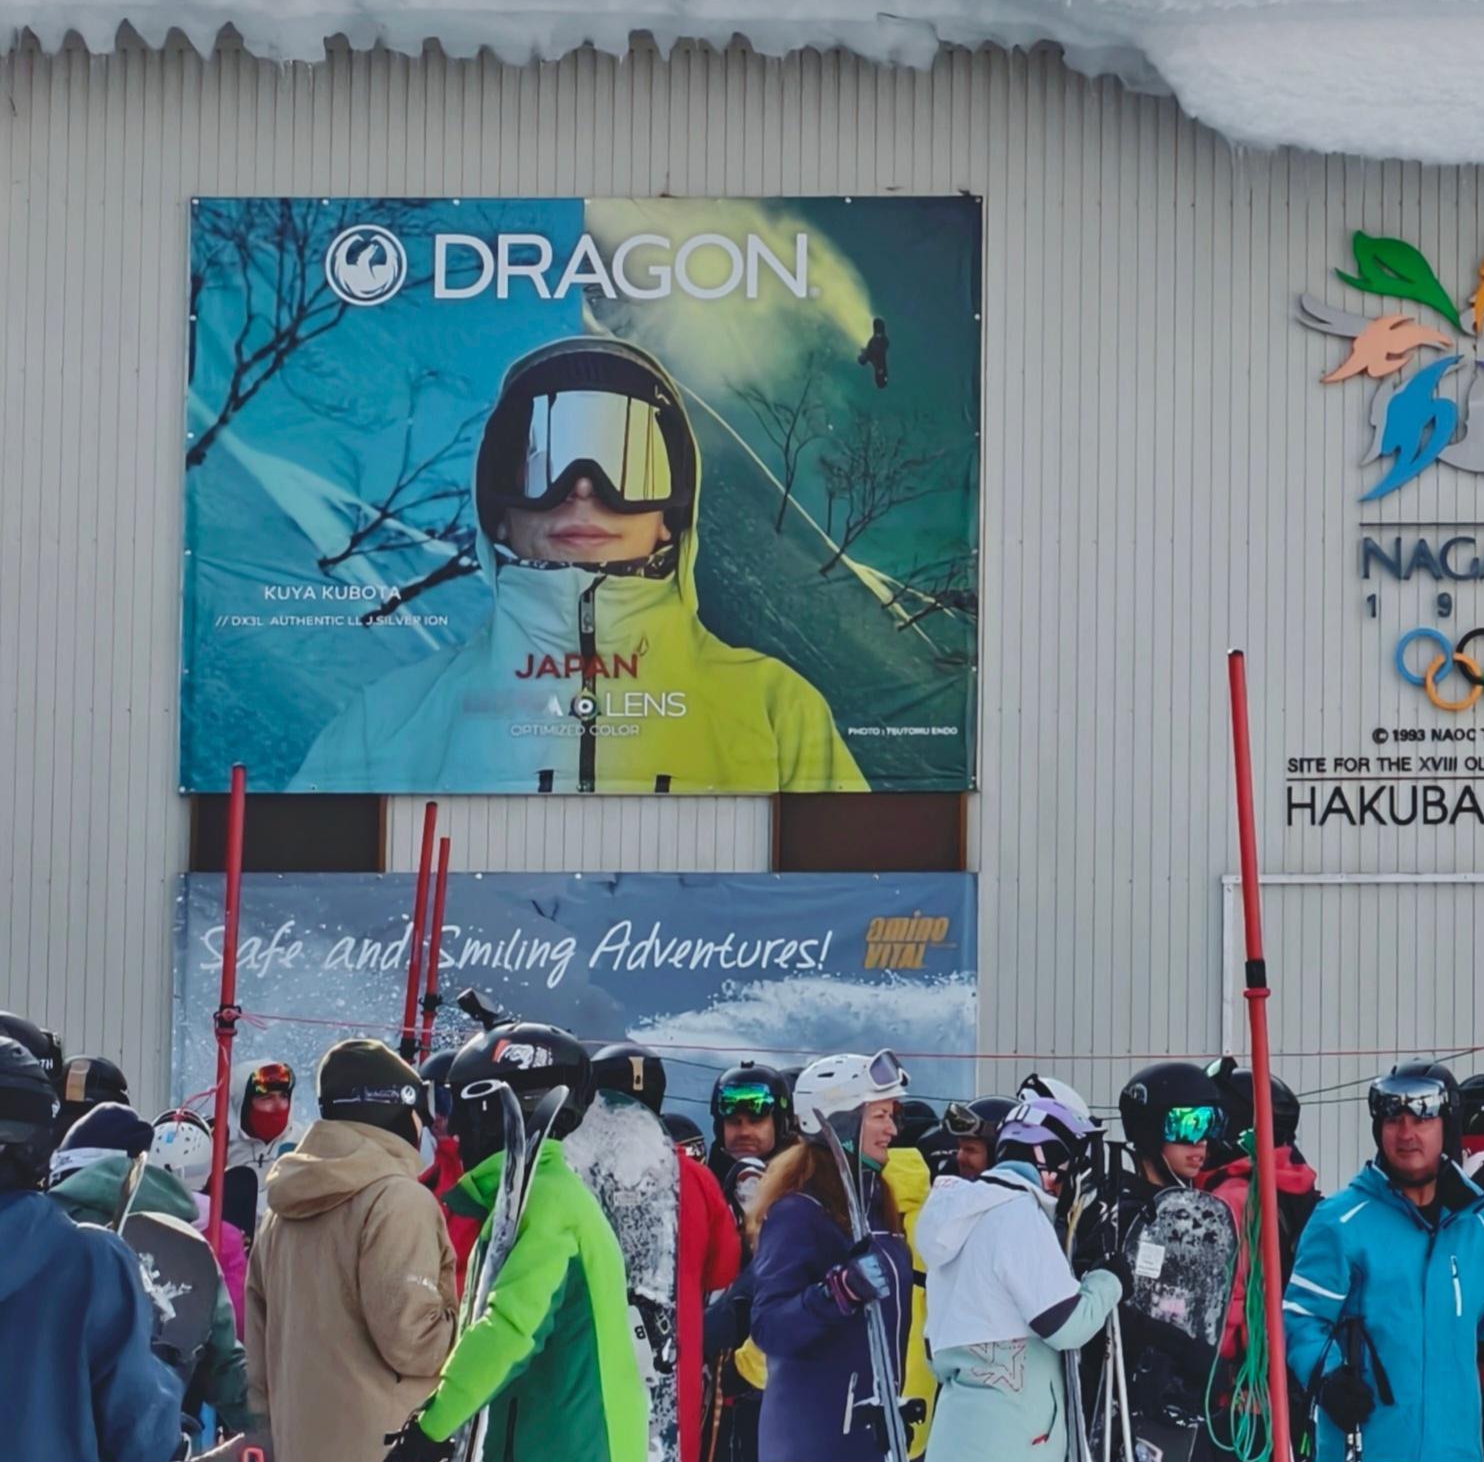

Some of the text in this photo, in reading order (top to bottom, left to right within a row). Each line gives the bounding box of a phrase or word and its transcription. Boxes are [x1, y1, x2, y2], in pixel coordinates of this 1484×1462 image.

[433, 233, 807, 300] DRAGON
[264, 585, 402, 601] KUYA KUBOTA
[269, 615, 345, 626] AUTHENTIC
[423, 615, 449, 626] ION
[515, 651, 639, 680] JAPAN
[605, 691, 687, 717] LENS
[509, 724, 641, 737] OPTIMIZED COLOR
[1392, 727, 1427, 743] 1993
[1430, 727, 1477, 743] NAOC
[1287, 756, 1327, 774] SITE
[1333, 756, 1371, 774] FOR
[1376, 756, 1413, 774] THE
[1417, 756, 1459, 773] XVIII
[865, 909, 951, 942] amino
[199, 919, 306, 979] Safe
[436, 924, 578, 990] Smiling
[589, 918, 834, 973] Adventures!
[863, 942, 929, 970] VITAL
